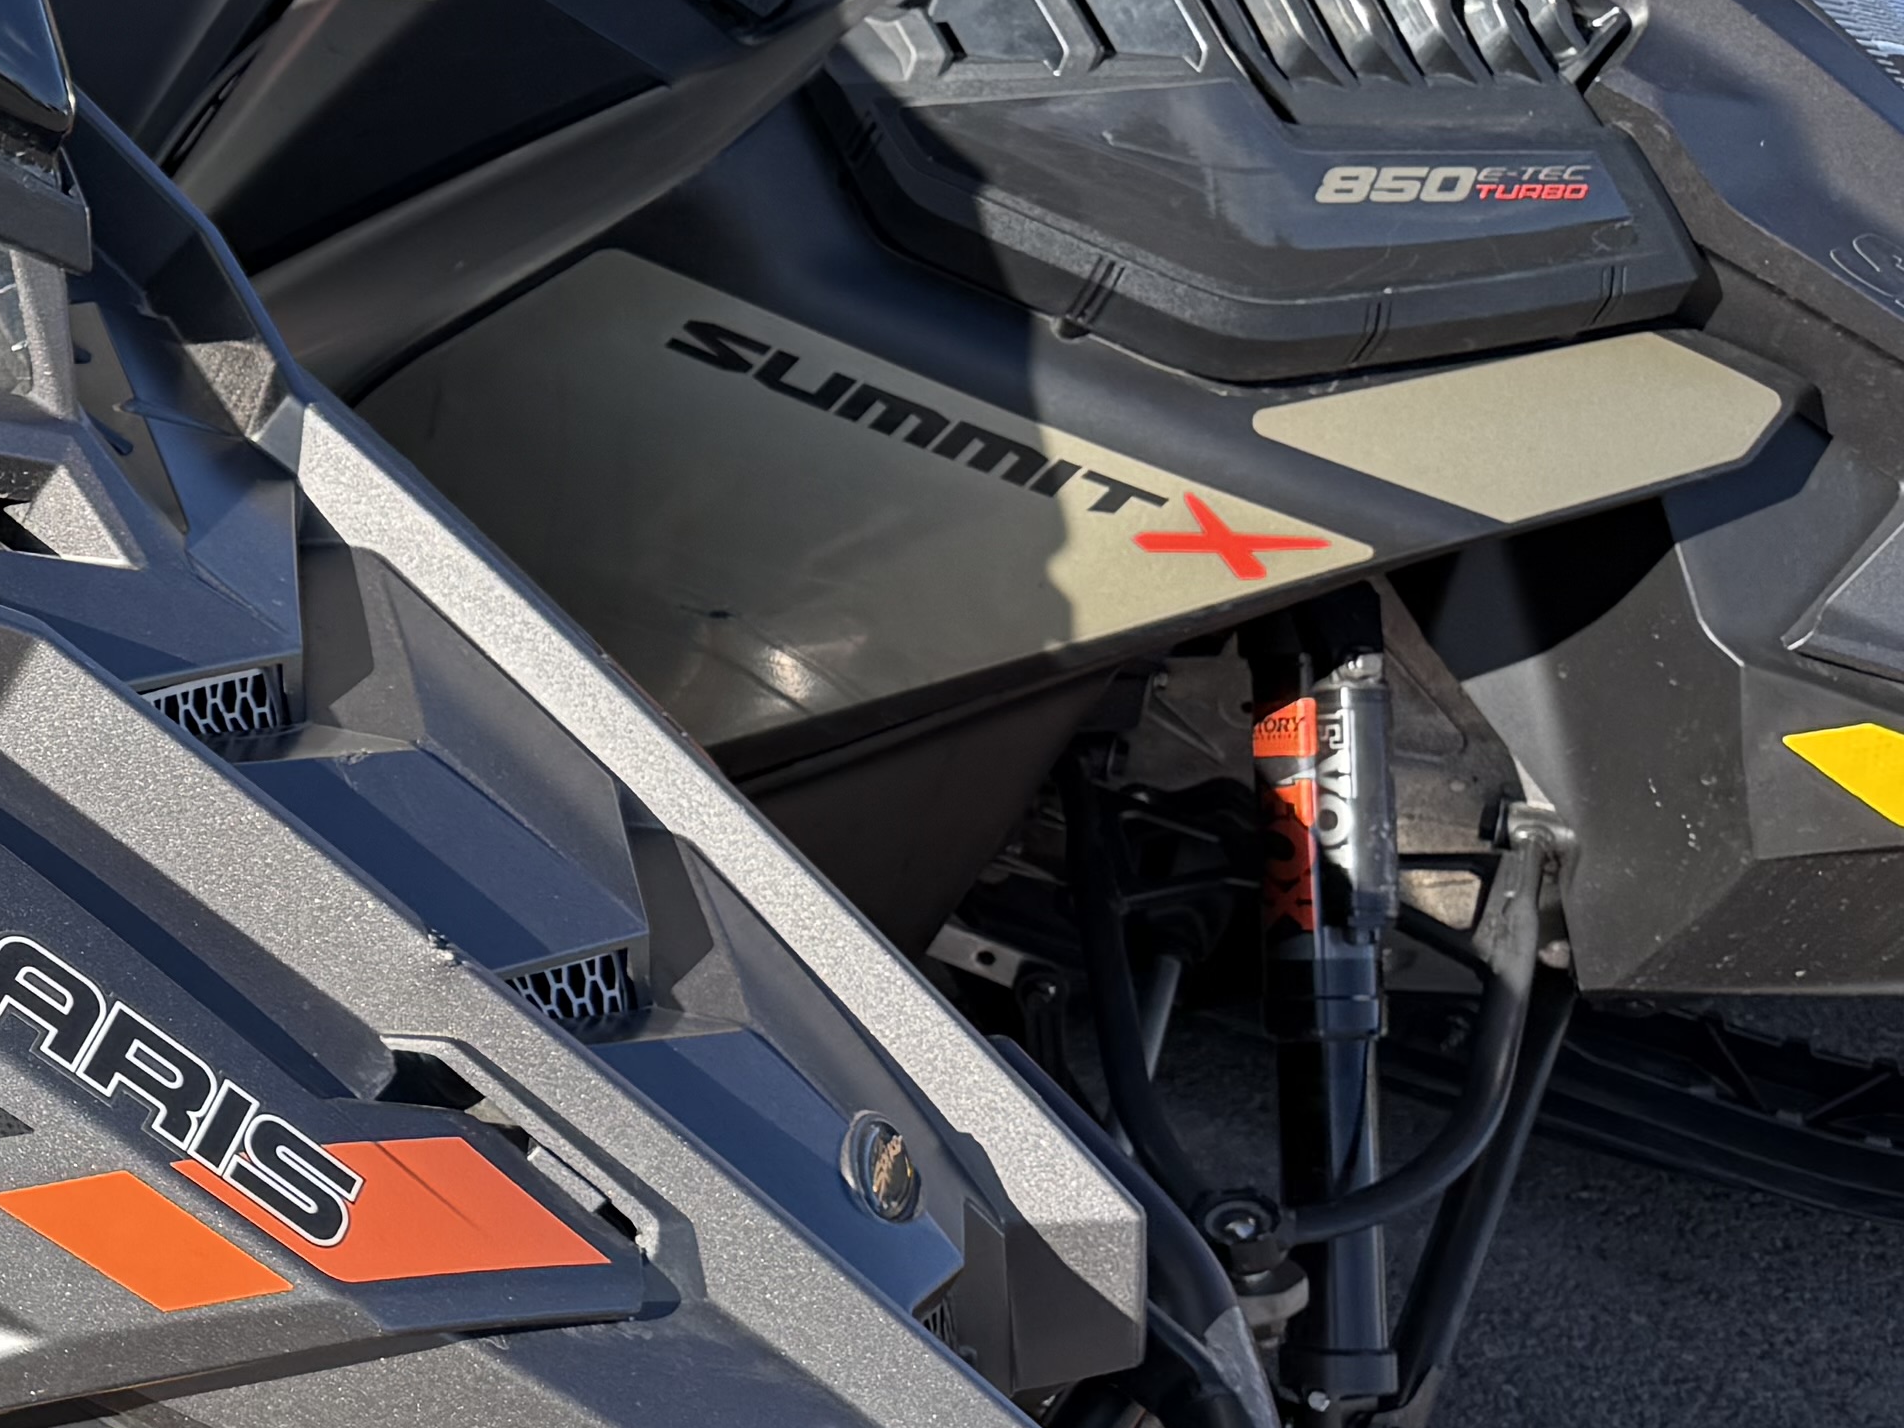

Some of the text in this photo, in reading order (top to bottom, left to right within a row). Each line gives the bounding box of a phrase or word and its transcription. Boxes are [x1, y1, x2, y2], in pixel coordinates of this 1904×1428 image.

[1315, 165, 1591, 203] 850 E-TEC
[1476, 183, 1589, 201] TURBO
[665, 320, 1332, 580] SUMMIT X
